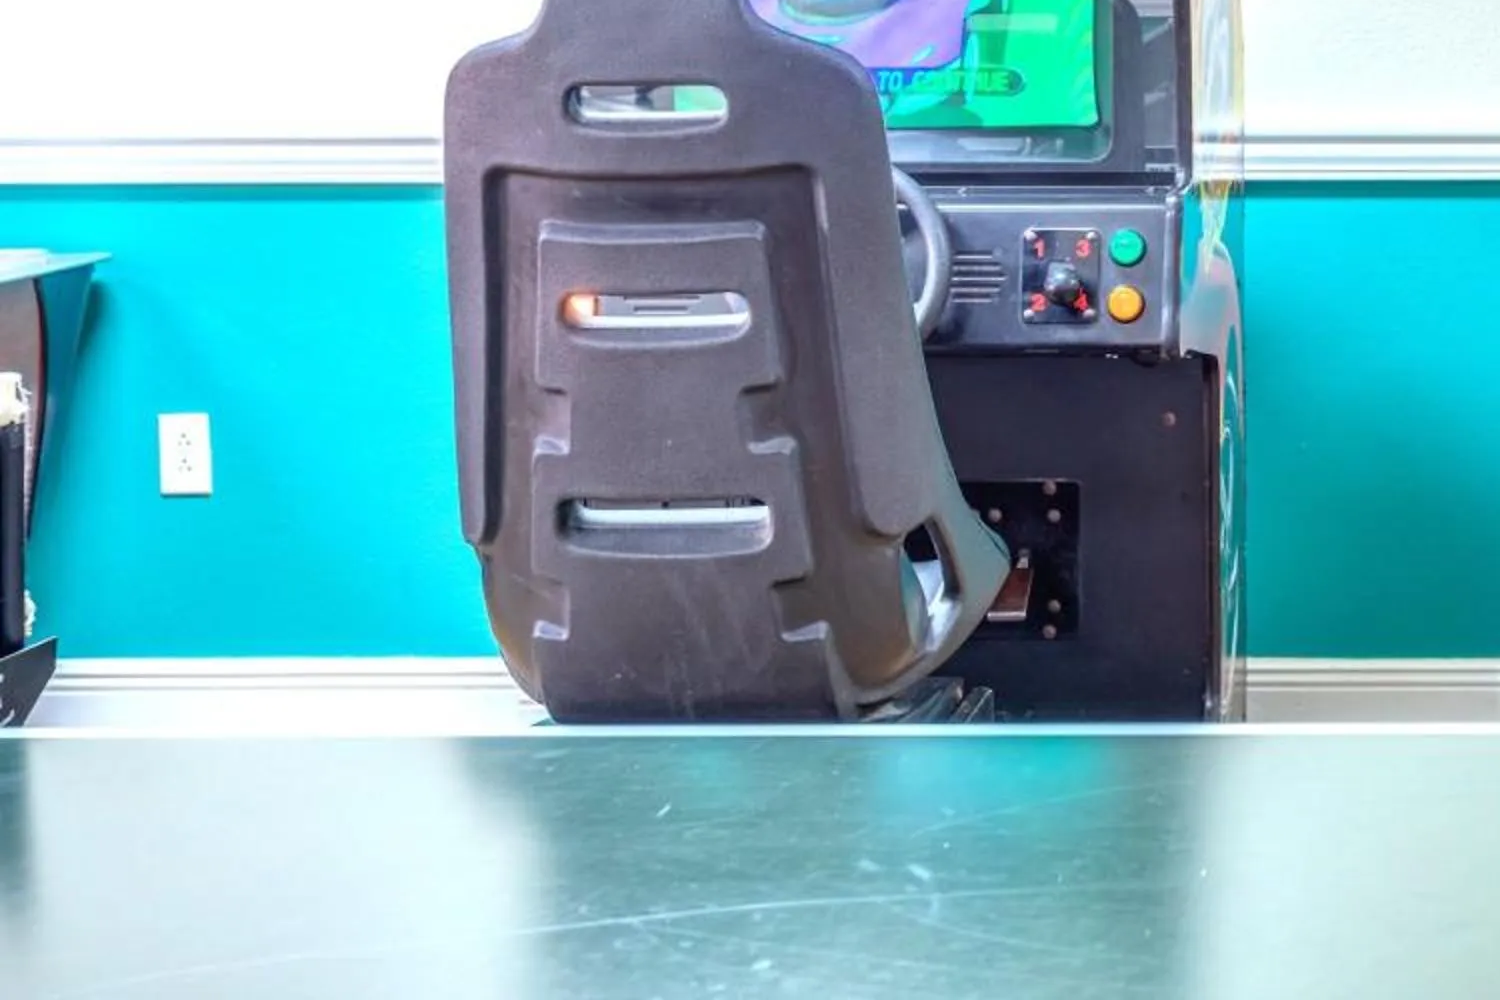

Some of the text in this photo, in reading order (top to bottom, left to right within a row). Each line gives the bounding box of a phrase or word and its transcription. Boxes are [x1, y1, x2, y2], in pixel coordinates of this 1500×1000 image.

[878, 70, 903, 92] TO
[1033, 239, 1091, 258] 1 3
[1030, 293, 1047, 312] 2
